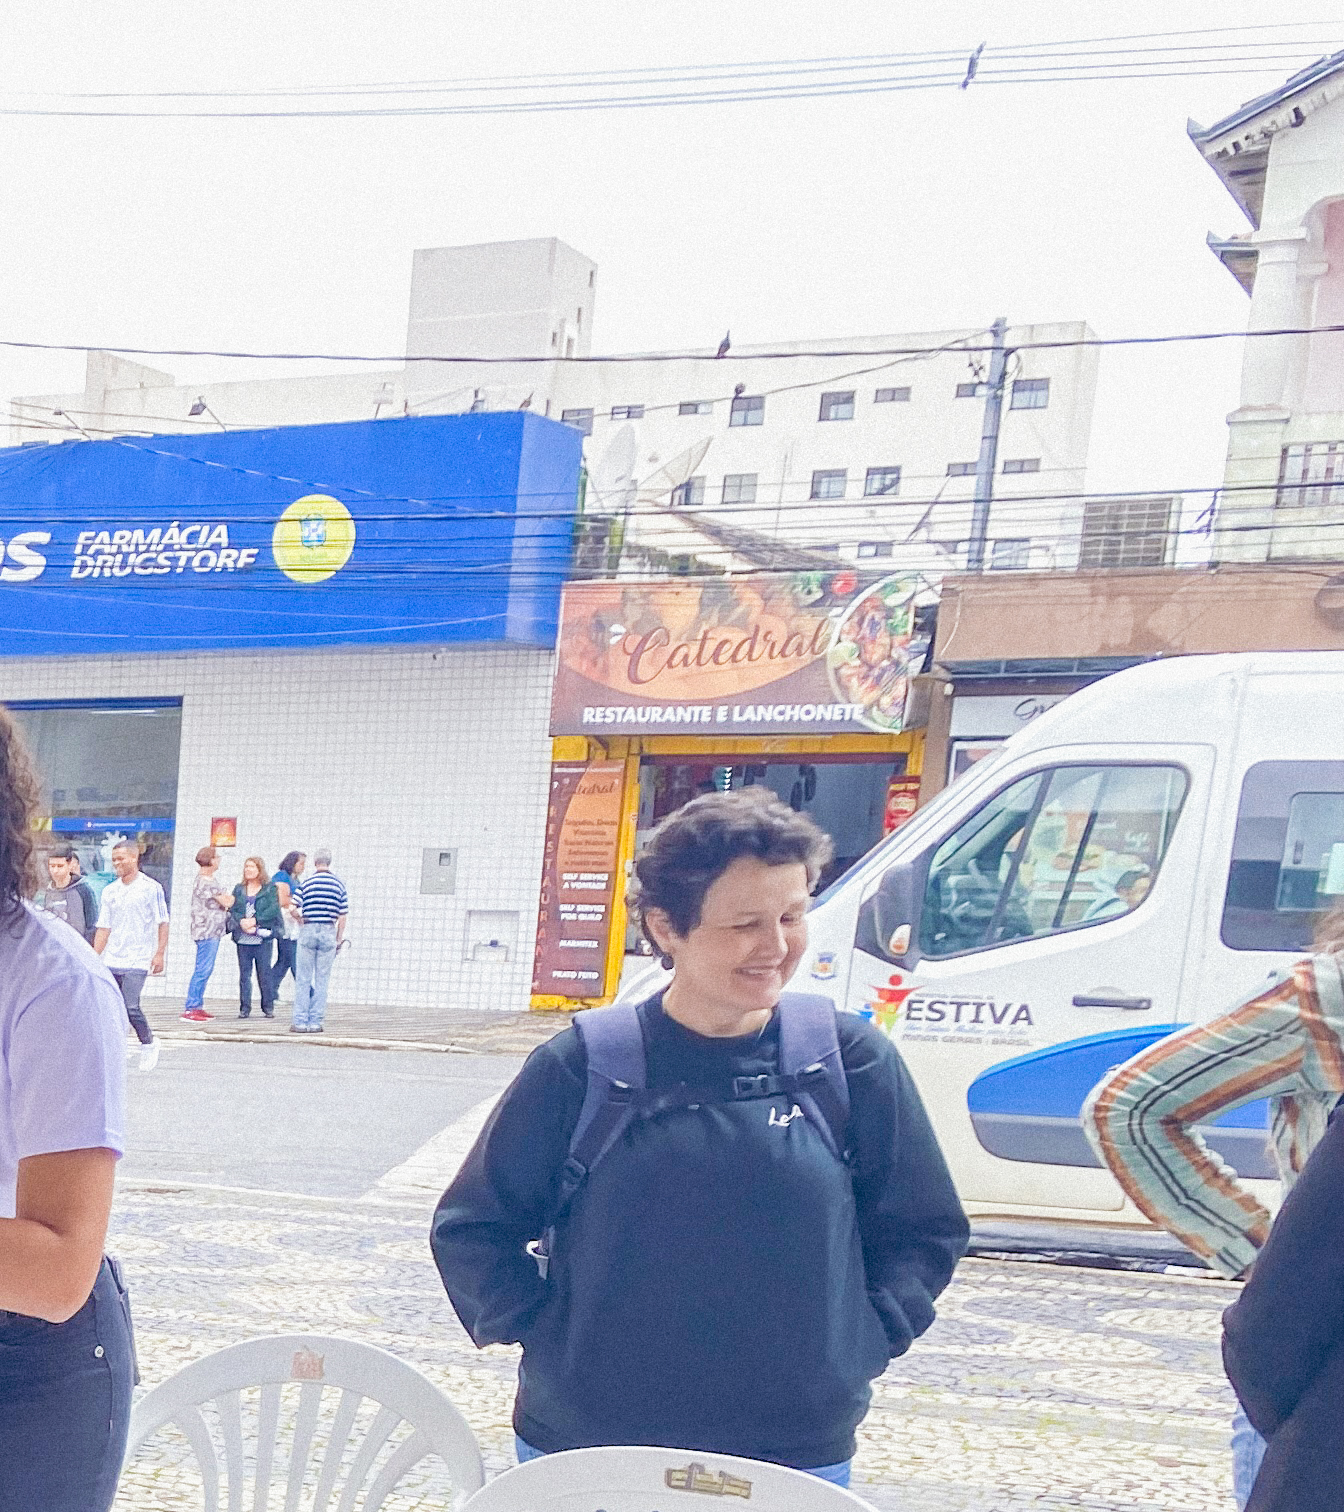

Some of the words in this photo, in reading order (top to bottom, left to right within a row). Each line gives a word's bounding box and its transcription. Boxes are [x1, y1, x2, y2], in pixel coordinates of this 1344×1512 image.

[74, 521, 230, 555] FARMÁCIA
[623, 614, 835, 685] Catedral
[582, 704, 712, 724] RESTAURANTE
[715, 703, 728, 722] E
[732, 702, 865, 723] LANCHONETE
[905, 999, 1034, 1026] ESTIVA
